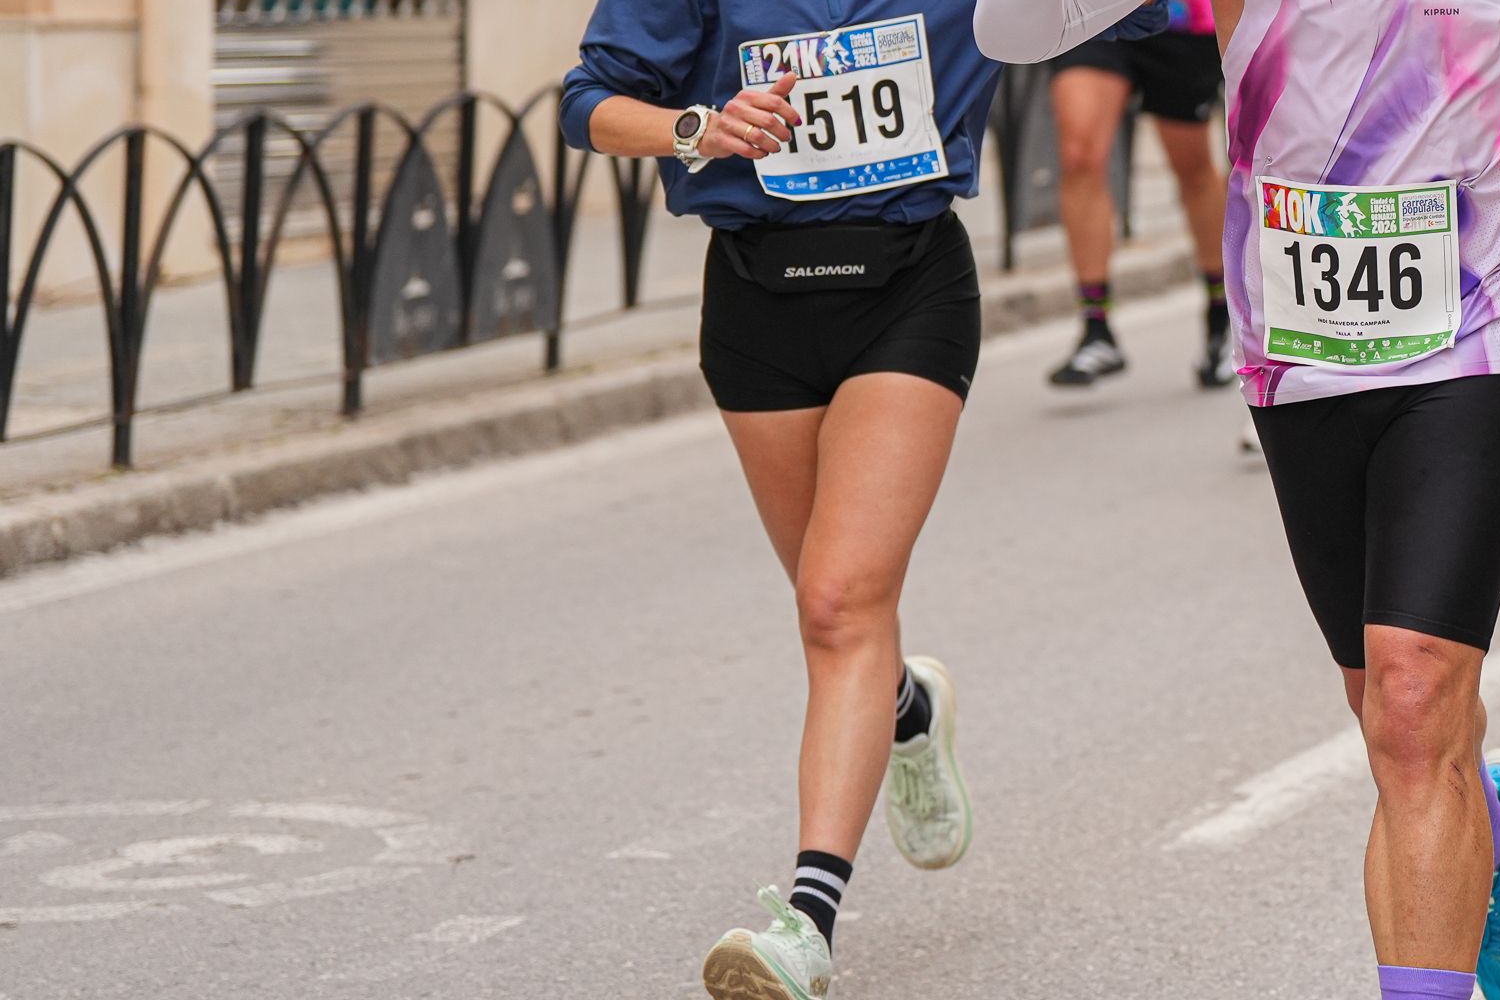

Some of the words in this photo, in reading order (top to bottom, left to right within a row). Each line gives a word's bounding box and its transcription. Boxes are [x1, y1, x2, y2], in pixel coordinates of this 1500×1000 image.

[1423, 8, 1460, 16] KIPRUN
[762, 38, 823, 83] 21K
[1370, 203, 1395, 213] LUCENA
[1402, 197, 1438, 208] carreras
[1402, 203, 1445, 216] populares
[1274, 188, 1324, 234] 10K
[1371, 220, 1397, 234] 2026
[784, 264, 865, 278] SALOMON
[1284, 241, 1422, 312] 1346
